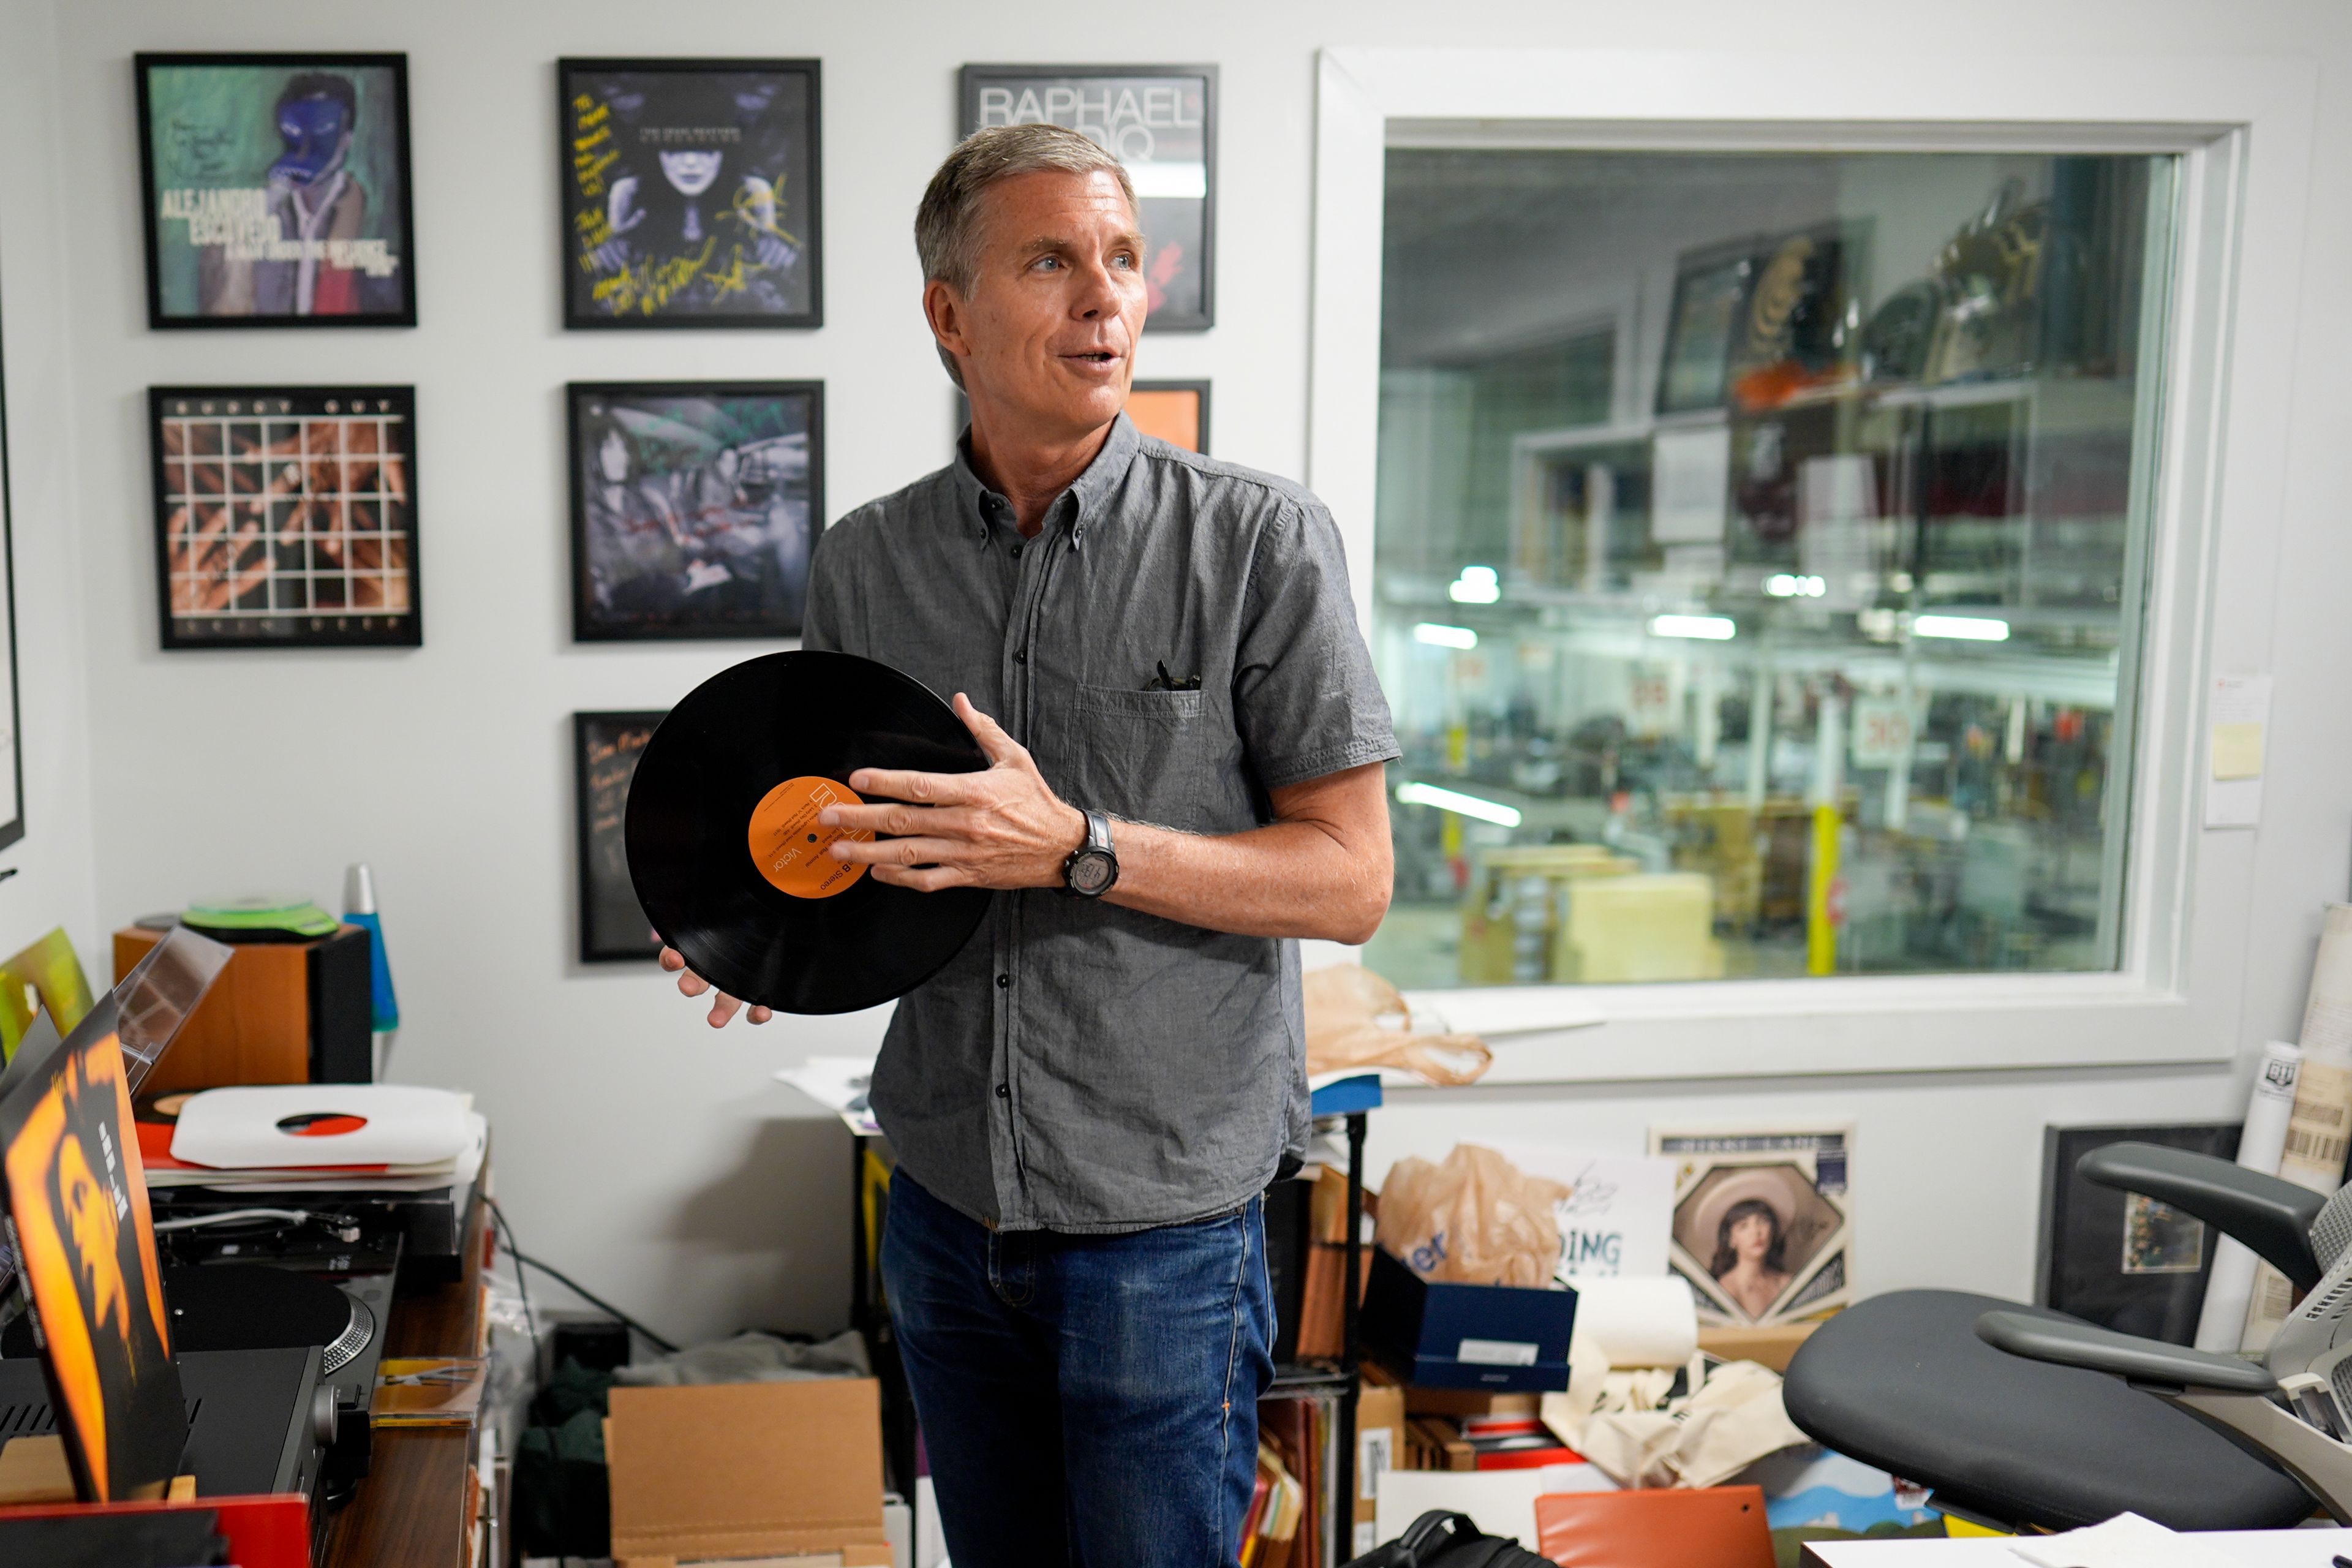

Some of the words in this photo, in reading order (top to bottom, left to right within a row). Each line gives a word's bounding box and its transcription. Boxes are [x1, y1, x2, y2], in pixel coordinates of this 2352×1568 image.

[980, 87, 1200, 128] RAPHAEL
[160, 188, 267, 221] ALEJANDRO
[189, 214, 281, 246] ESCOVEDO
[819, 846, 829, 856] Roll
[822, 834, 832, 845] Reed
[773, 848, 802, 872] Victor
[805, 854, 820, 868] Animal
[842, 863, 851, 873] B
[820, 869, 844, 891] Stereo
[1400, 1231, 1448, 1272] er
